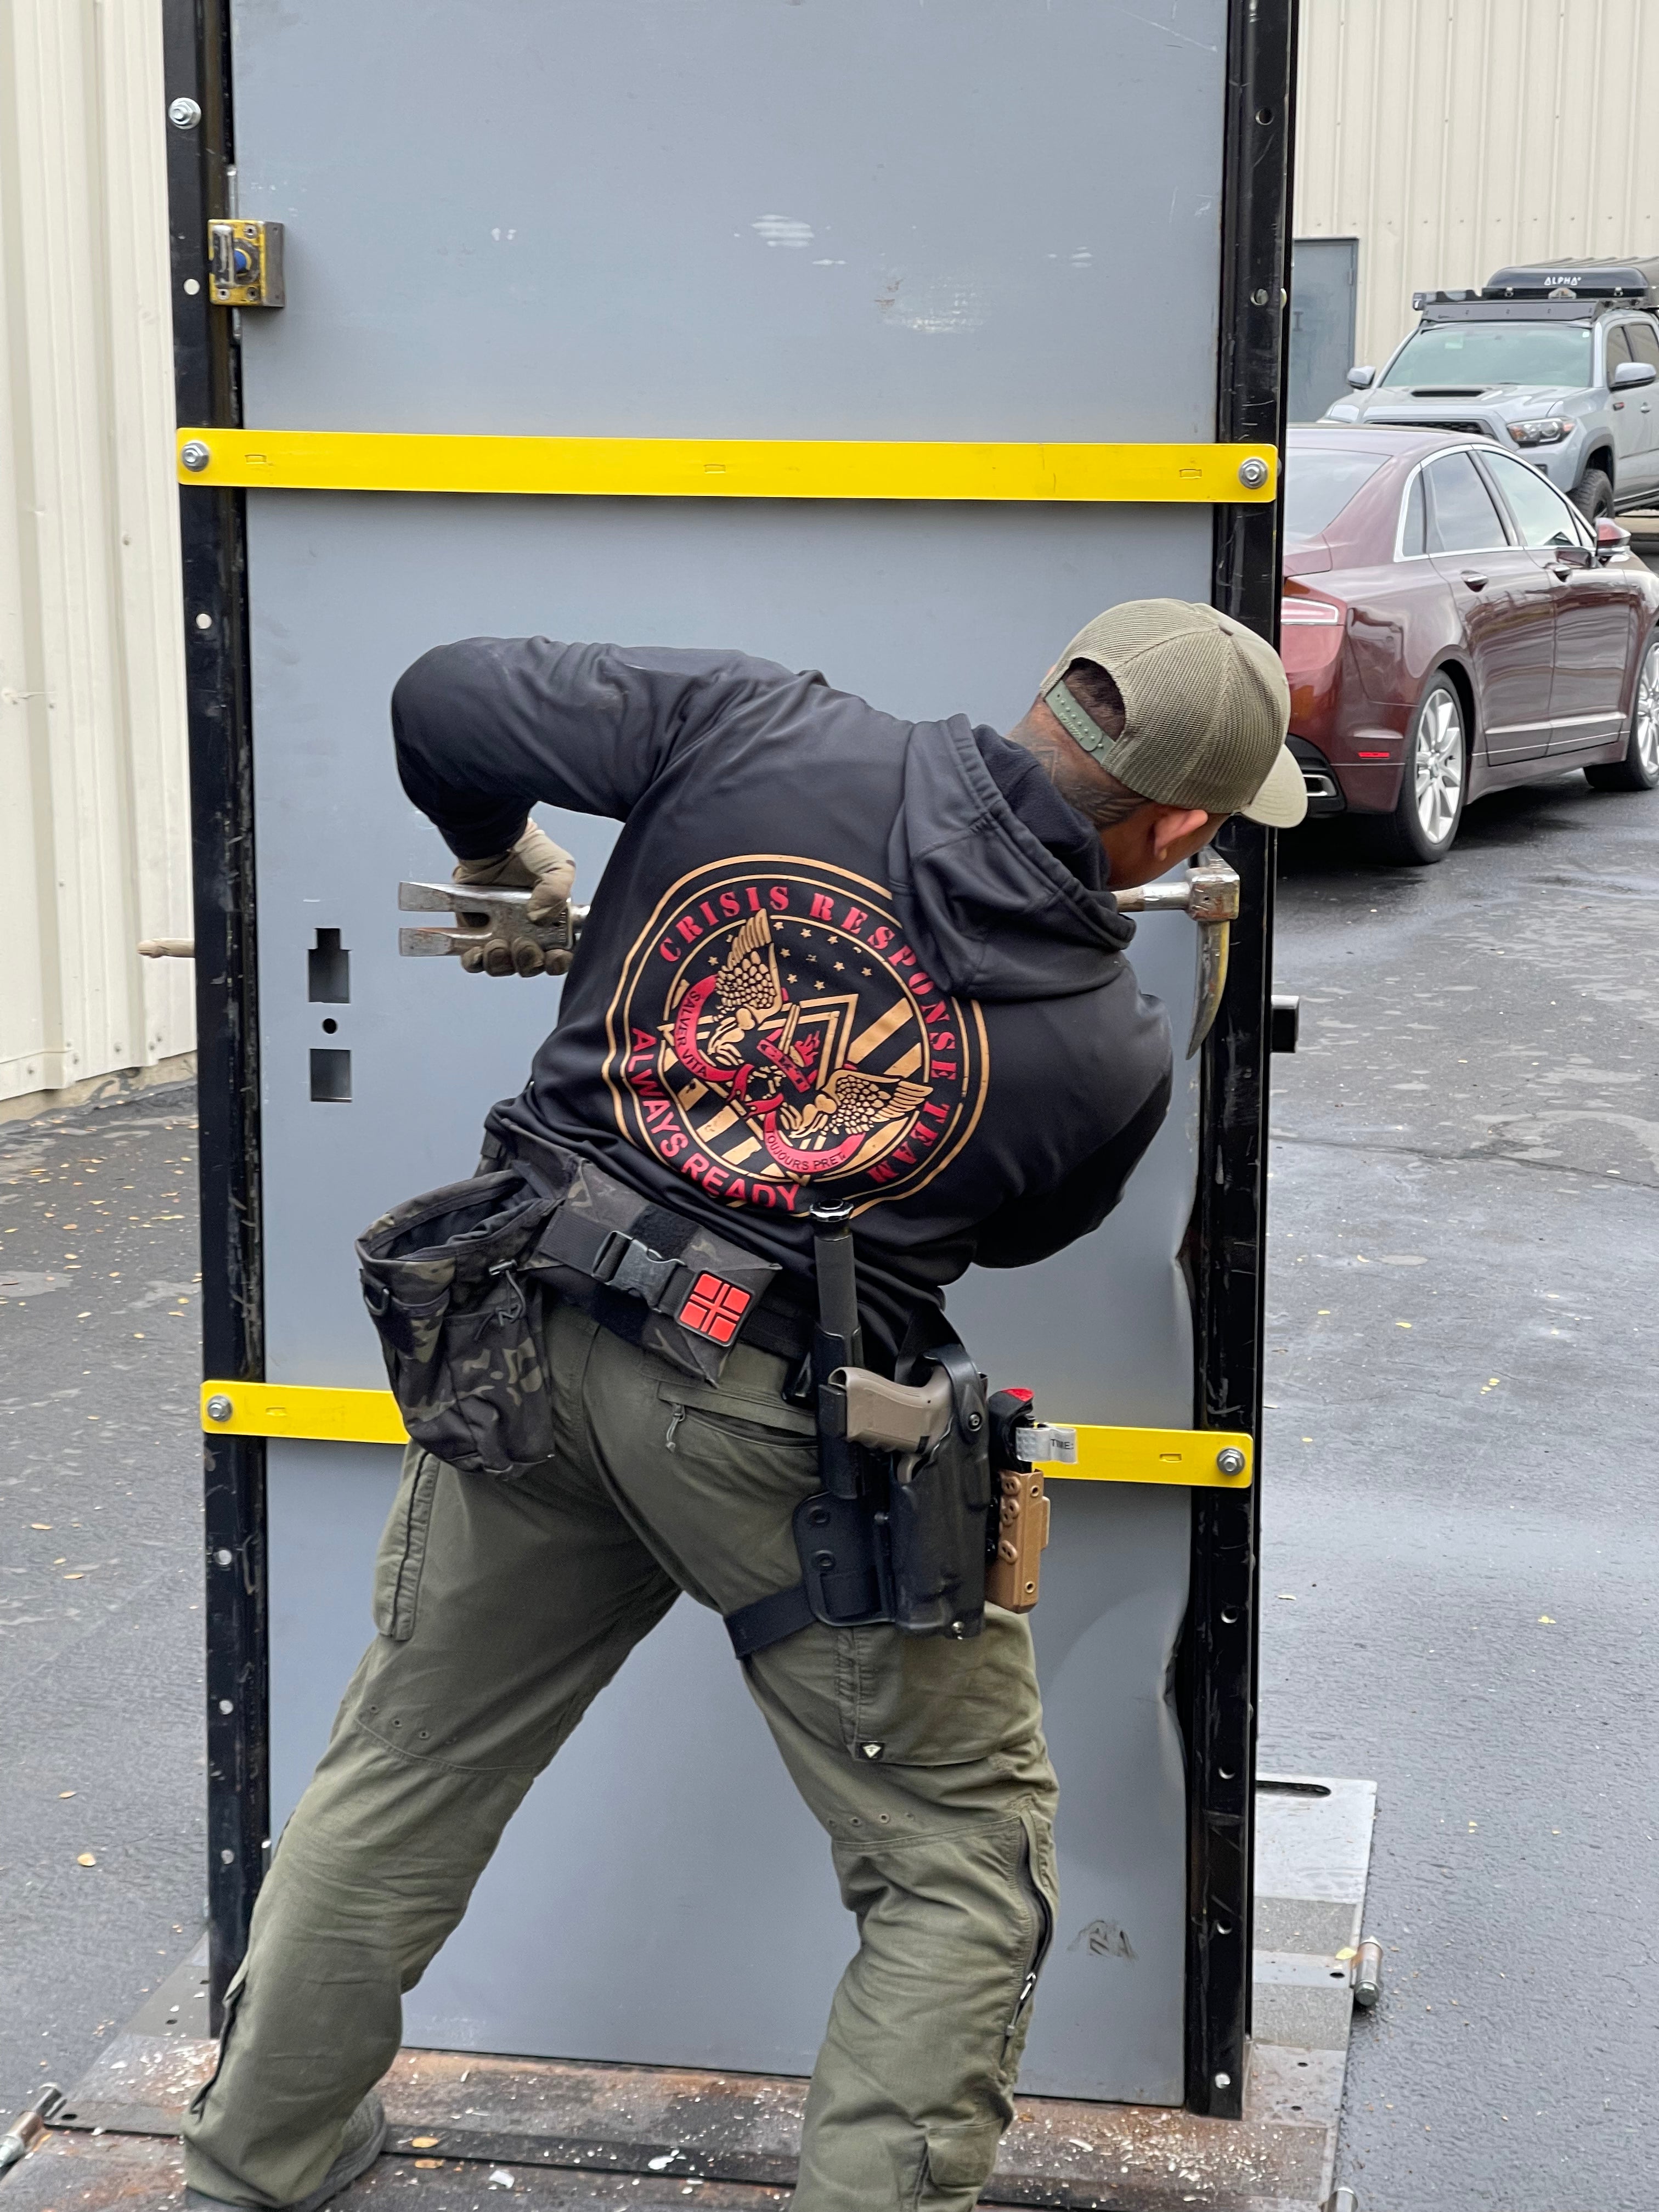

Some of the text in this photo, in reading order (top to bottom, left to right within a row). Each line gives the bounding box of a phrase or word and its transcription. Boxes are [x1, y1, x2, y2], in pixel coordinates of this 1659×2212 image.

[1544, 276, 1578, 286] ALPHA
[659, 885, 789, 962] CRISIS
[809, 894, 957, 1080] RESPONSE
[682, 1048, 707, 1077] VITA
[627, 1028, 687, 1158] ALWAYS
[681, 1153, 800, 1211] READY
[766, 1128, 809, 1171] TOUJOURS
[866, 1101, 951, 1183] TEAM
